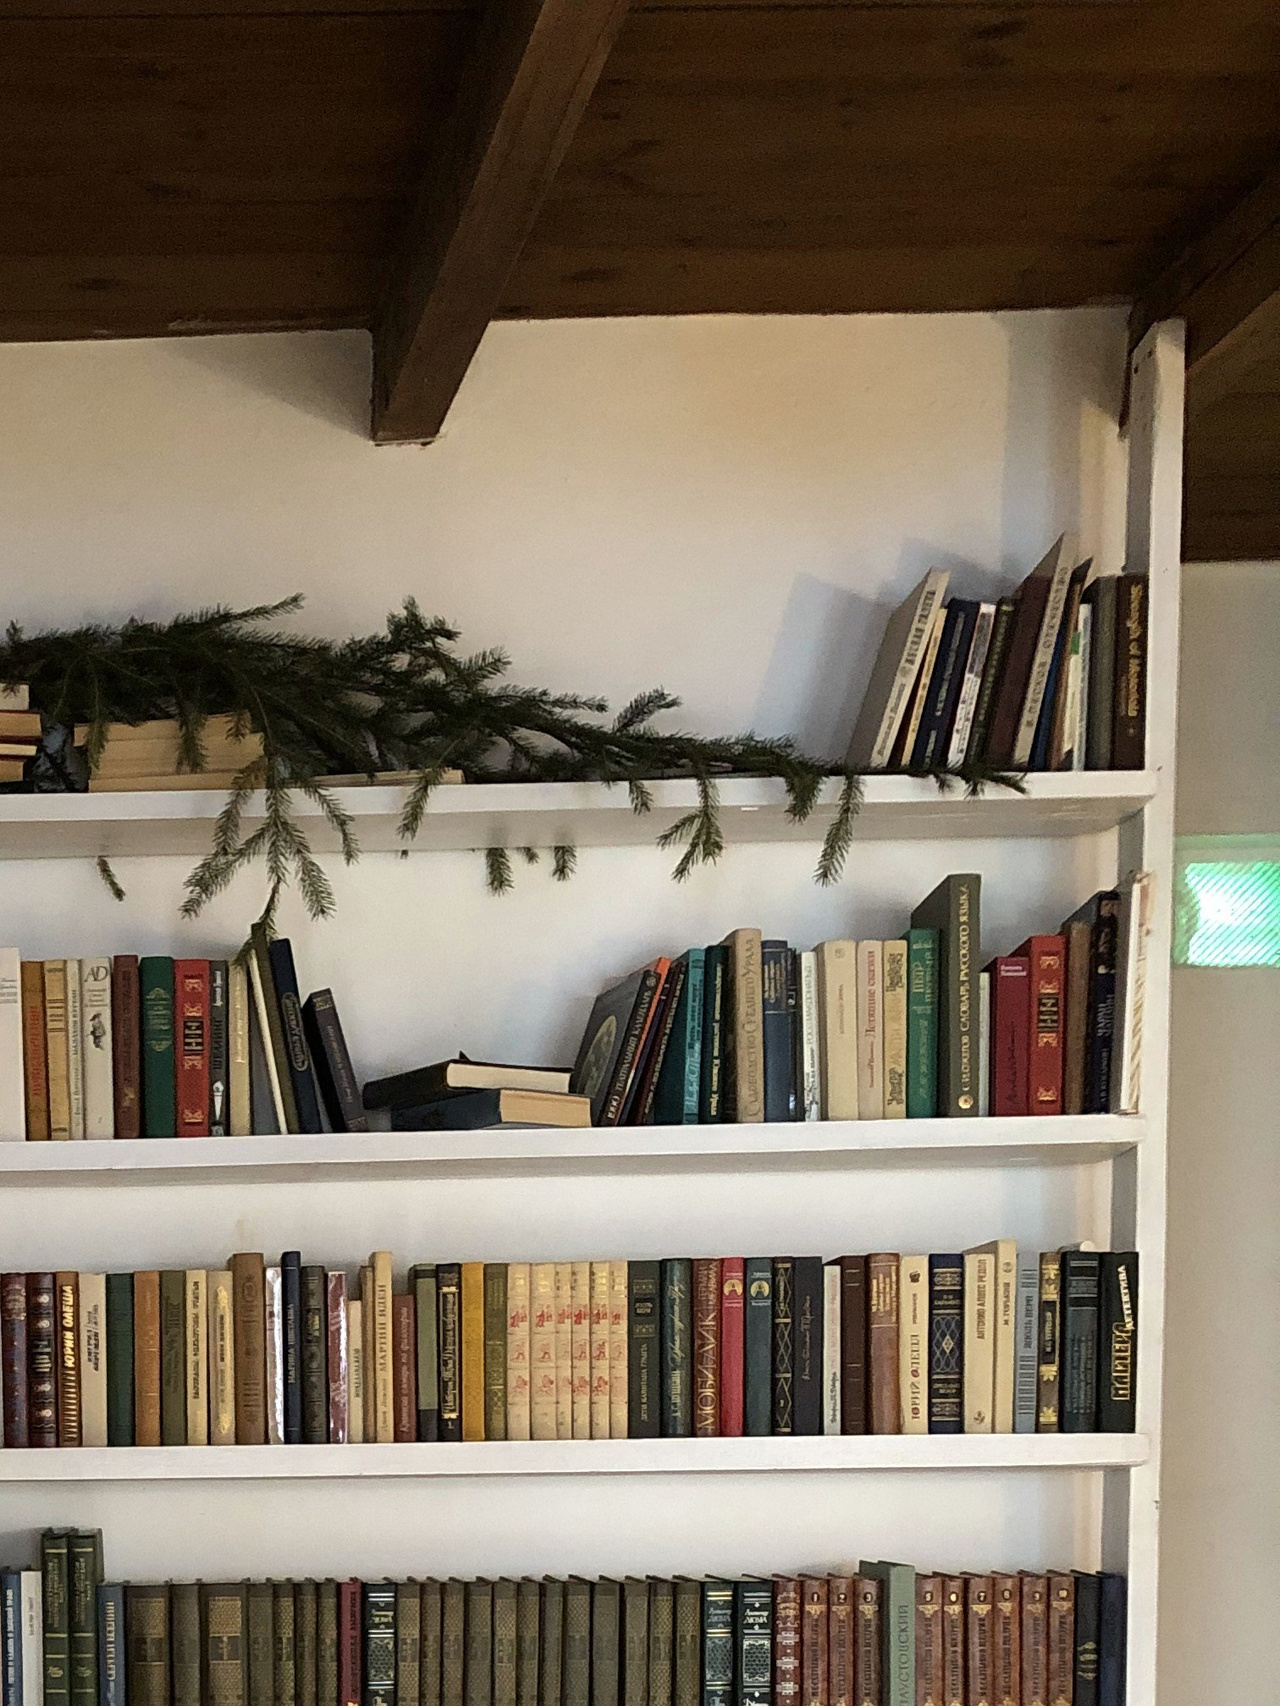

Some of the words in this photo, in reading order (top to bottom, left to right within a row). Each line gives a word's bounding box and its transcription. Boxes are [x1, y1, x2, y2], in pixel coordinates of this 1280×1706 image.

[959, 884, 969, 922] ЯЗЫКА
[742, 938, 755, 977] УРАЛА
[867, 951, 876, 986] сказки
[959, 925, 970, 980] РУССКОГО
[743, 977, 757, 1034] СРЕДНЕГО
[865, 990, 876, 1038] Летящие
[961, 983, 970, 1031] СЛОВАРЬ
[697, 1265, 706, 1300] ГЕРМАН
[976, 1258, 987, 1282] РЕДОЛ
[60, 1284, 74, 1328] ОЛЕША
[376, 1284, 386, 1317] ИДЕН
[1002, 1281, 1011, 1316] ГОРЬКИЙ
[1023, 1295, 1033, 1318] ВЕРН
[1116, 1263, 1136, 1330] ДЕТЕКТИВА
[284, 1302, 295, 1345] ЦВЕТАЕВА
[695, 1310, 718, 1360] ДИК
[975, 1308, 987, 1339] АНТОНИО
[1023, 1319, 1033, 1348] ЖЮЛЬ
[62, 1330, 76, 1367] ЮРИЙ
[285, 1347, 296, 1383] МАРИНА
[377, 1321, 387, 1372] МАРТИН
[639, 1342, 648, 1367] ГРАНТА
[908, 1333, 921, 1378] ОЛЕША
[695, 1363, 719, 1429] МОБИ
[909, 1380, 922, 1419] ЮРИЙ
